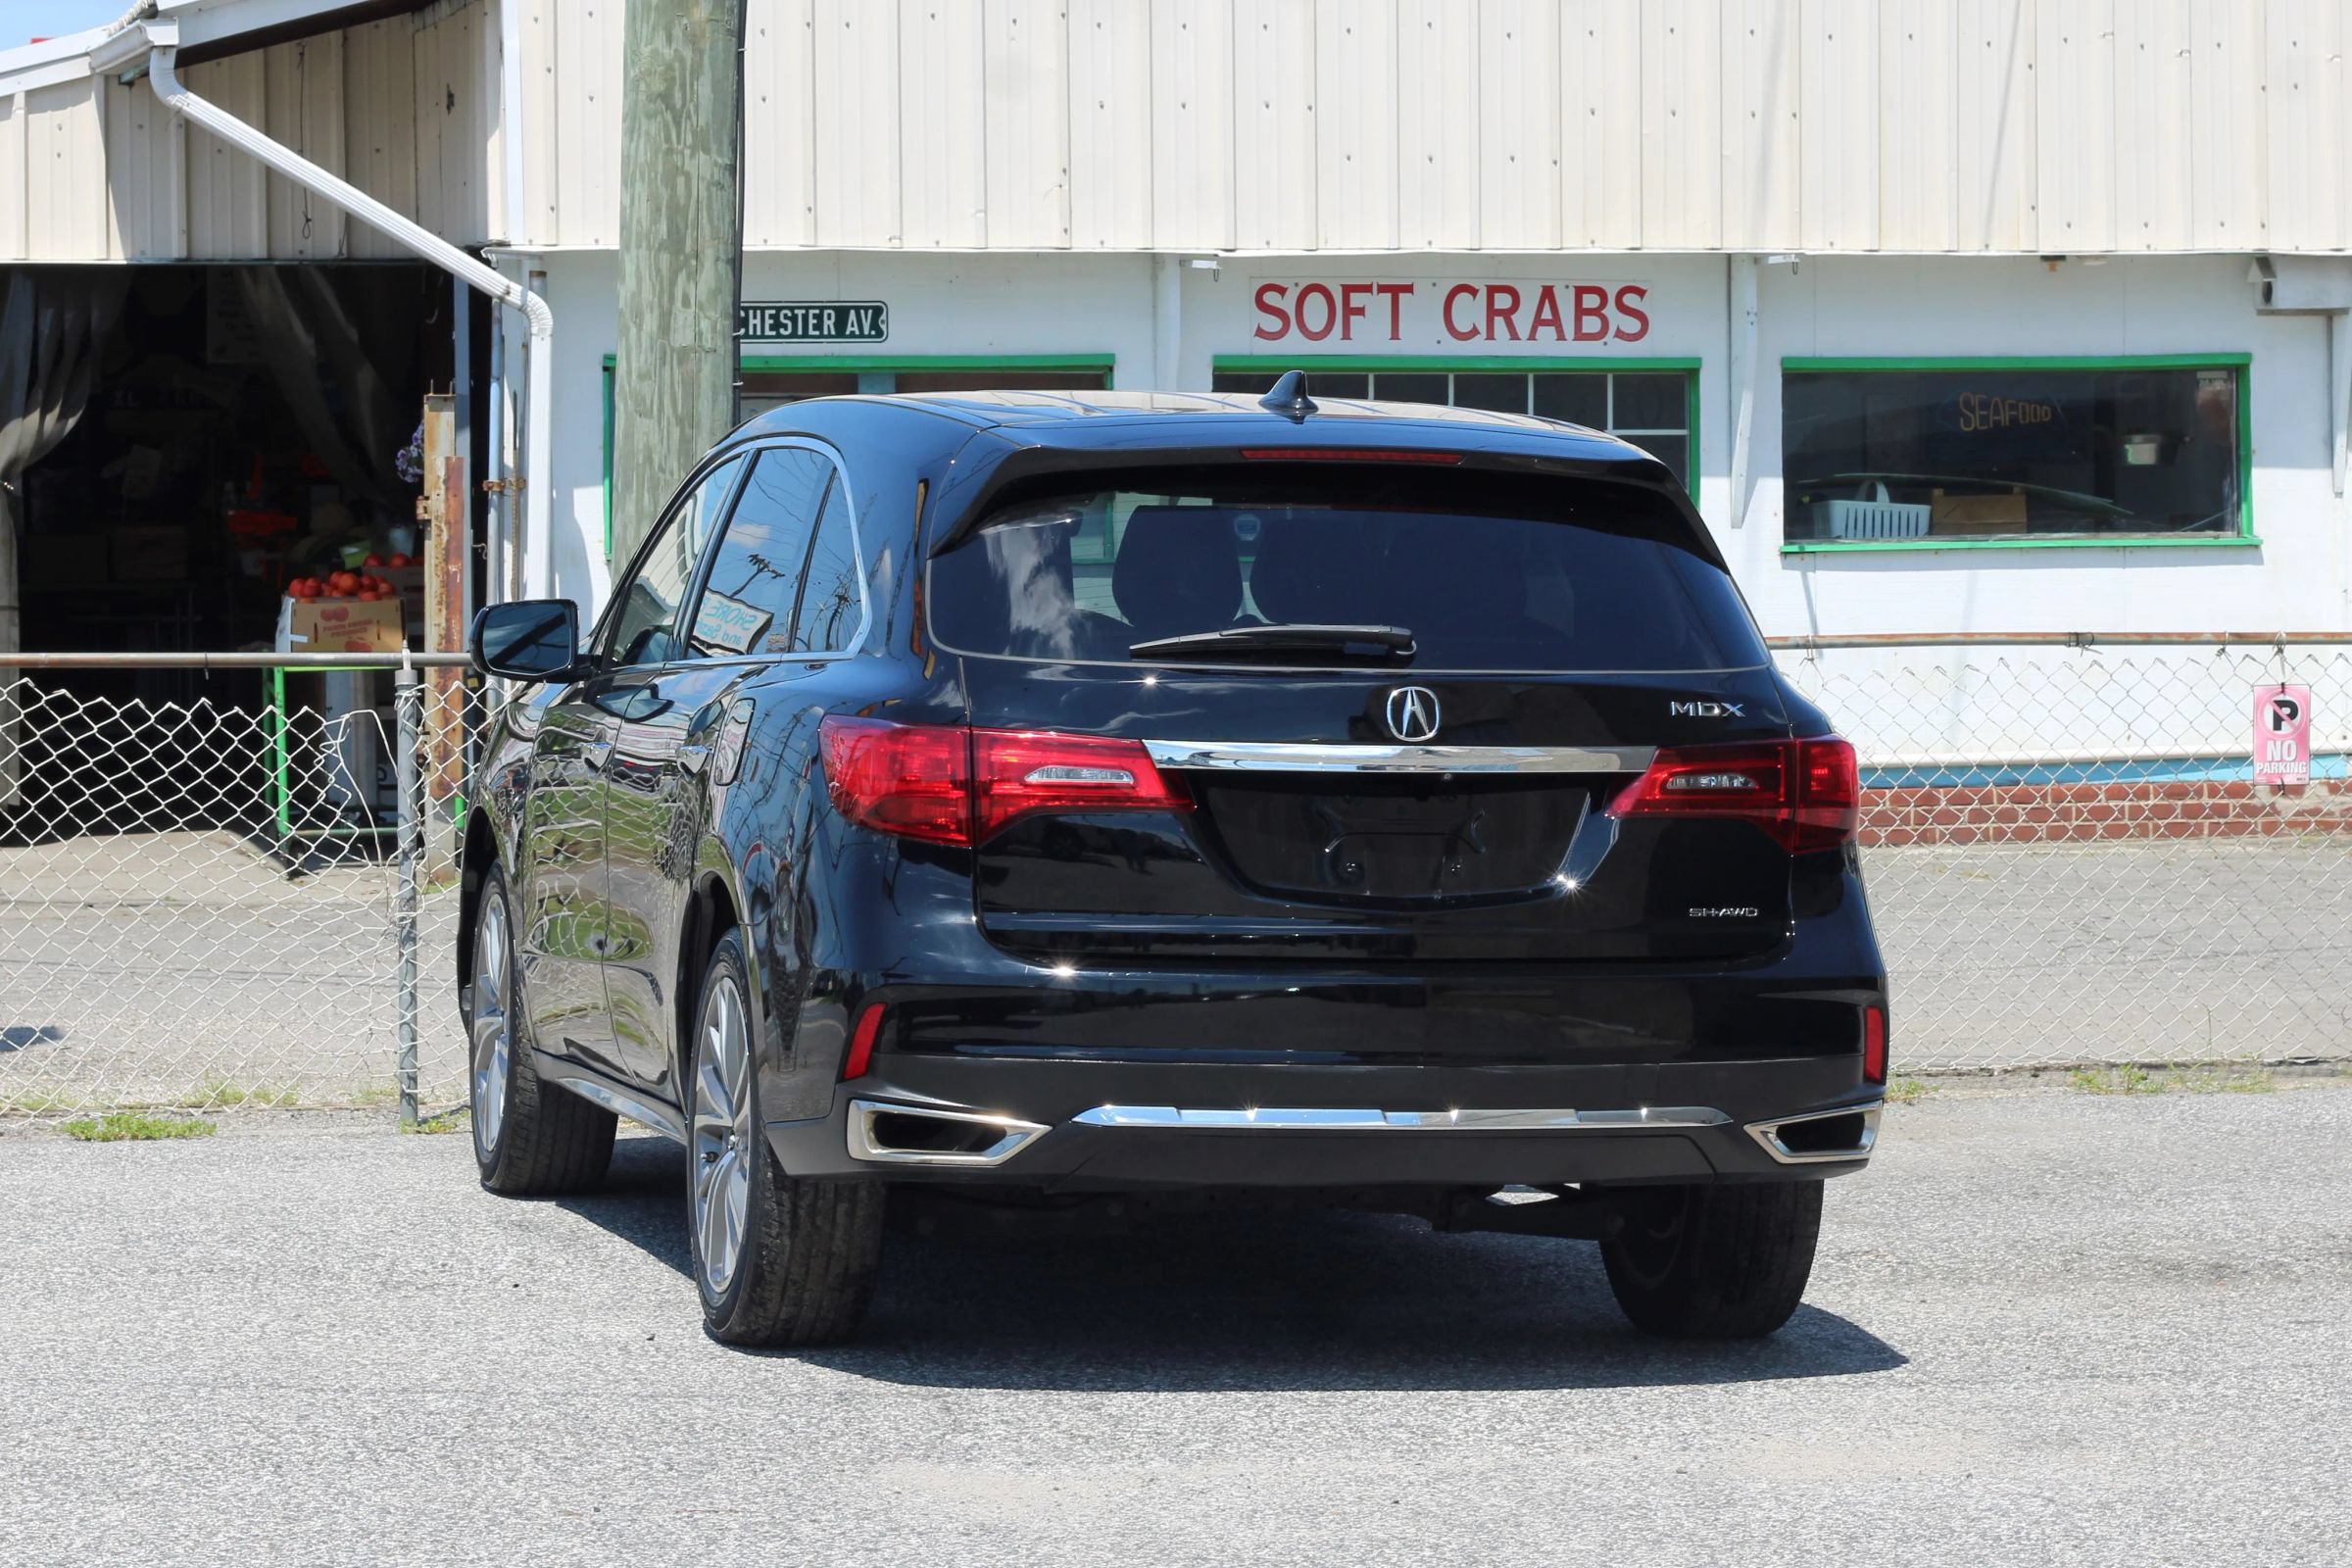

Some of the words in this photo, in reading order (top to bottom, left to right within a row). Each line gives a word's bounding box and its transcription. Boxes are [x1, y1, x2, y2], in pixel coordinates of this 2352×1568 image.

[845, 309, 875, 336] AV.
[1253, 281, 1414, 341] SOFT
[1443, 283, 1650, 343] CRABS
[1959, 391, 2052, 432] SEAFOOD
[1671, 701, 1746, 717] MDX
[2266, 739, 2298, 761] NO
[2256, 760, 2307, 774] PARKING
